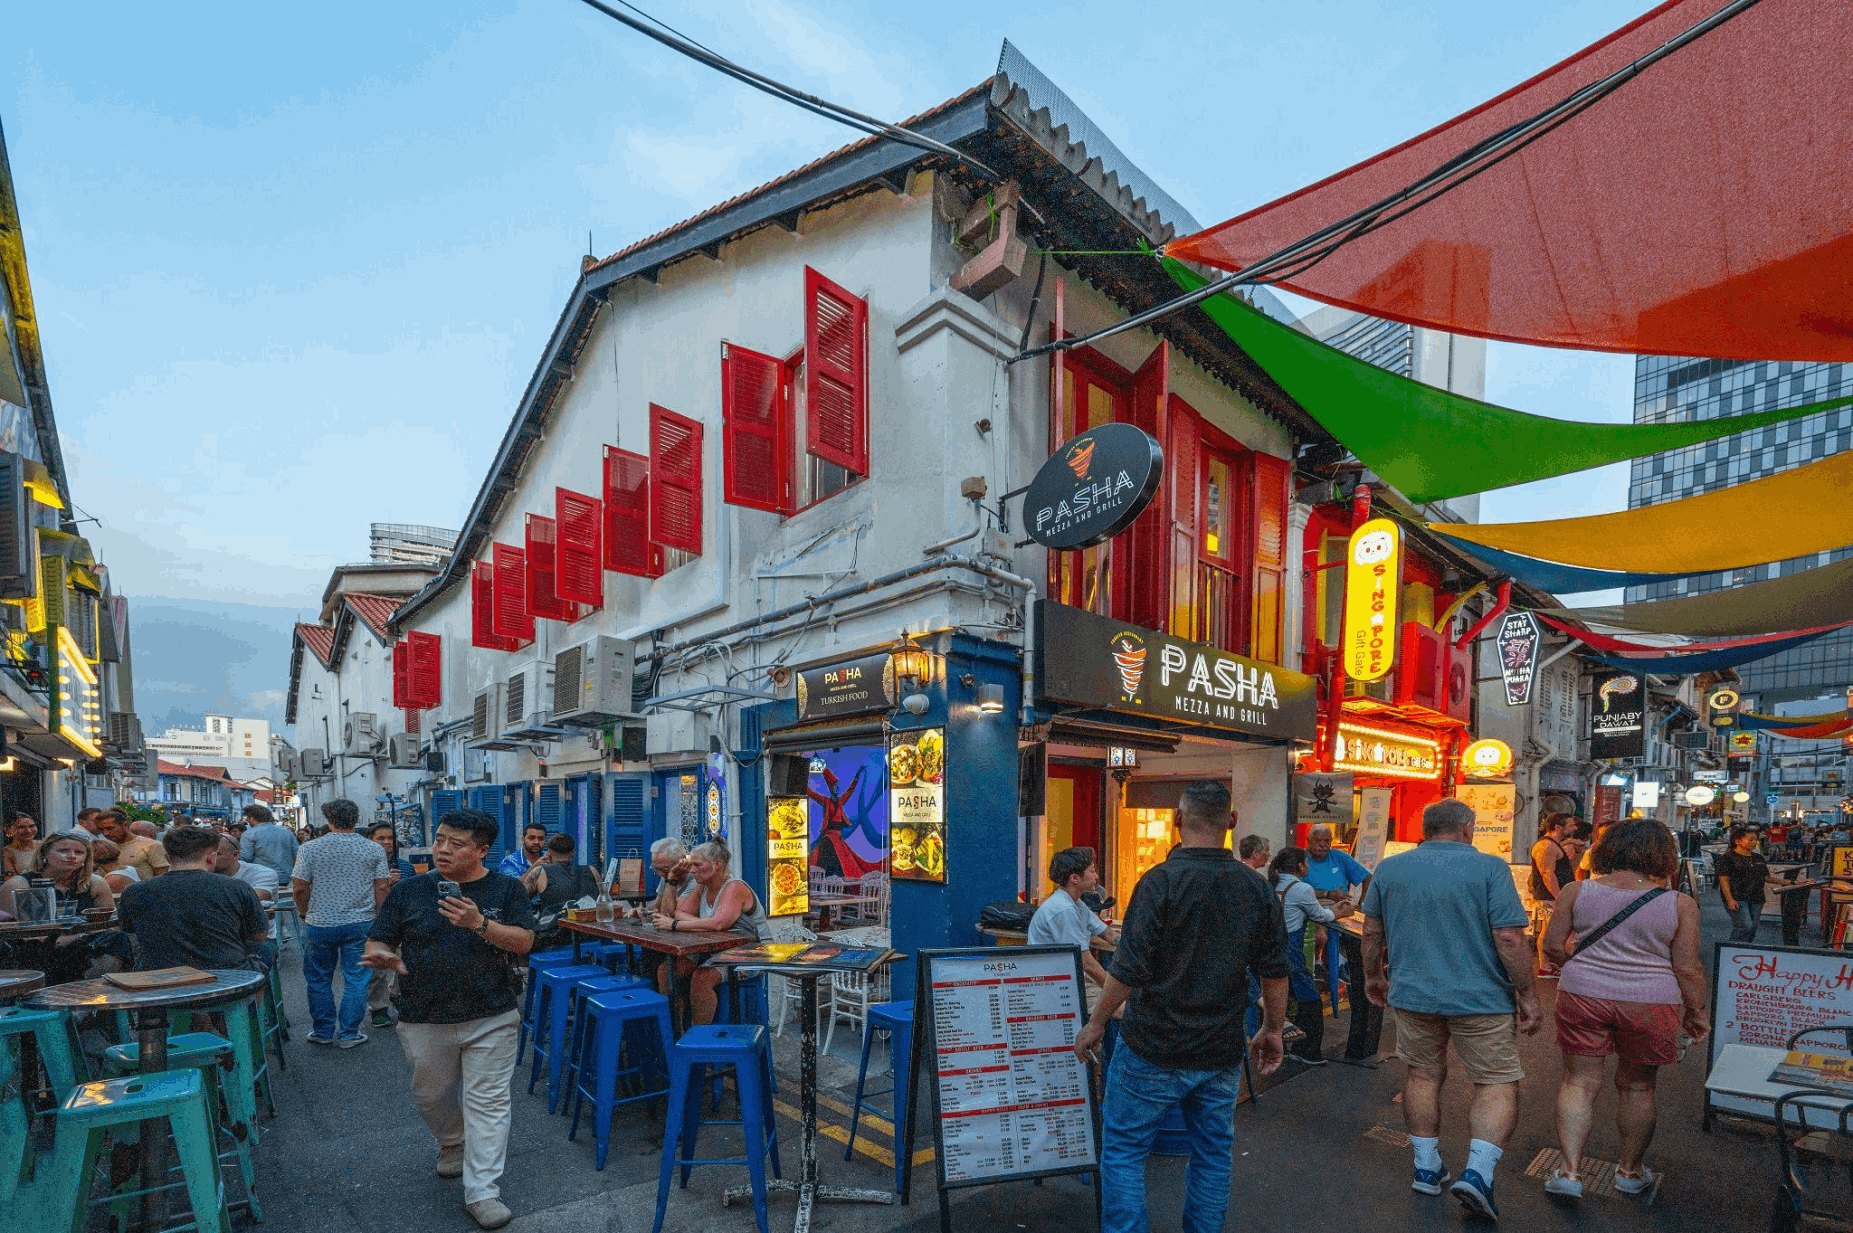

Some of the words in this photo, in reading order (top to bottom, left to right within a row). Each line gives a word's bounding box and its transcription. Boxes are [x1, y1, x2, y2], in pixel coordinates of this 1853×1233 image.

[1036, 469, 1134, 532] PASHA
[1046, 521, 1071, 538] MEZZA
[1075, 510, 1092, 524] AND
[1096, 496, 1123, 514] GRILL
[1507, 619, 1528, 630] STAY
[1356, 629, 1367, 649] Gift
[1504, 627, 1532, 639] SHARP
[1354, 651, 1366, 676] Gate
[824, 666, 862, 684] PASHA
[1161, 643, 1279, 710] PASHA
[820, 693, 848, 705] TURKISH
[849, 690, 869, 701] FOOD
[1175, 695, 1210, 716] MEZZA
[1216, 703, 1235, 720] AND
[1240, 708, 1267, 726] GRILL
[1593, 711, 1642, 723] PUNJABY
[1599, 719, 1635, 729] DAWAT
[898, 795, 937, 810] PASHA
[773, 841, 804, 851] PASHA
[984, 962, 1018, 972] PASHA
[1731, 954, 1824, 989] Happy
[1728, 980, 1786, 995] DRAUGHT
[1792, 988, 1837, 1001] BEERS
[1736, 992, 1801, 1004] CARLSBERG
[1736, 999, 1813, 1012] KRONENBOURG
[1818, 1007, 1853, 1017] BLANC
[1736, 1004, 1783, 1014] SAPPORO
[1787, 1010, 1836, 1021] PREMIUM
[1735, 1015, 1787, 1028] BROOKLYN
[1736, 1010, 1785, 1020] SAPPORO
[1791, 1016, 1827, 1026] BLACK
[1740, 1023, 1797, 1036] BOTTLES
